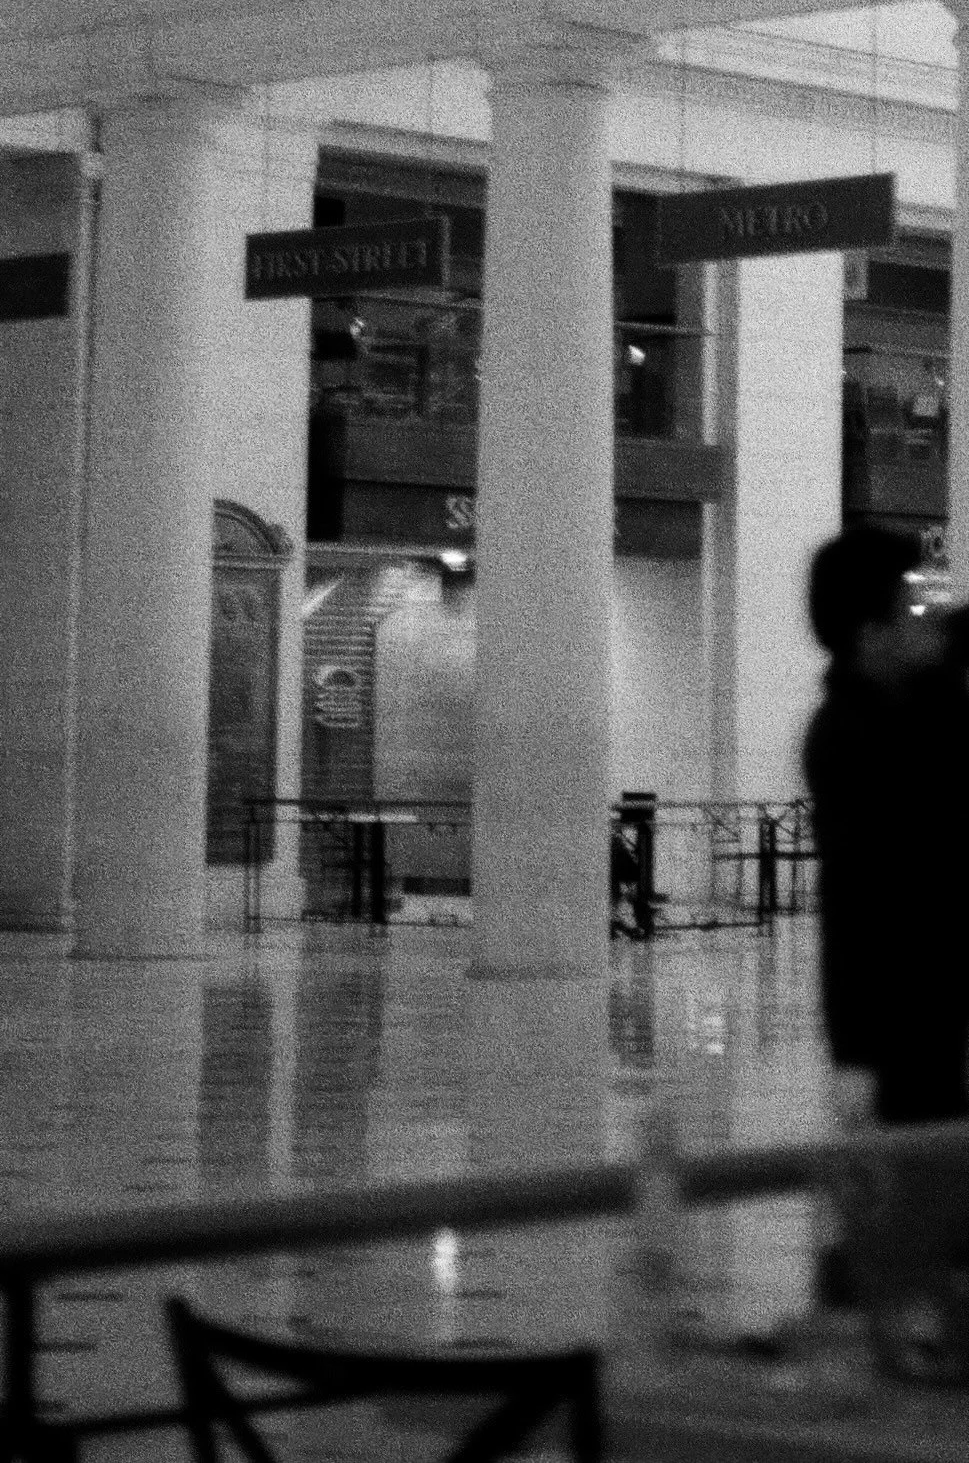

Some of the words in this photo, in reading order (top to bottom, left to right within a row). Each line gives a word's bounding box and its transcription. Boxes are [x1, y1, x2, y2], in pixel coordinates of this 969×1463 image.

[720, 201, 829, 236] METRO
[253, 248, 323, 280] FIRST
[329, 239, 429, 274] STREET
